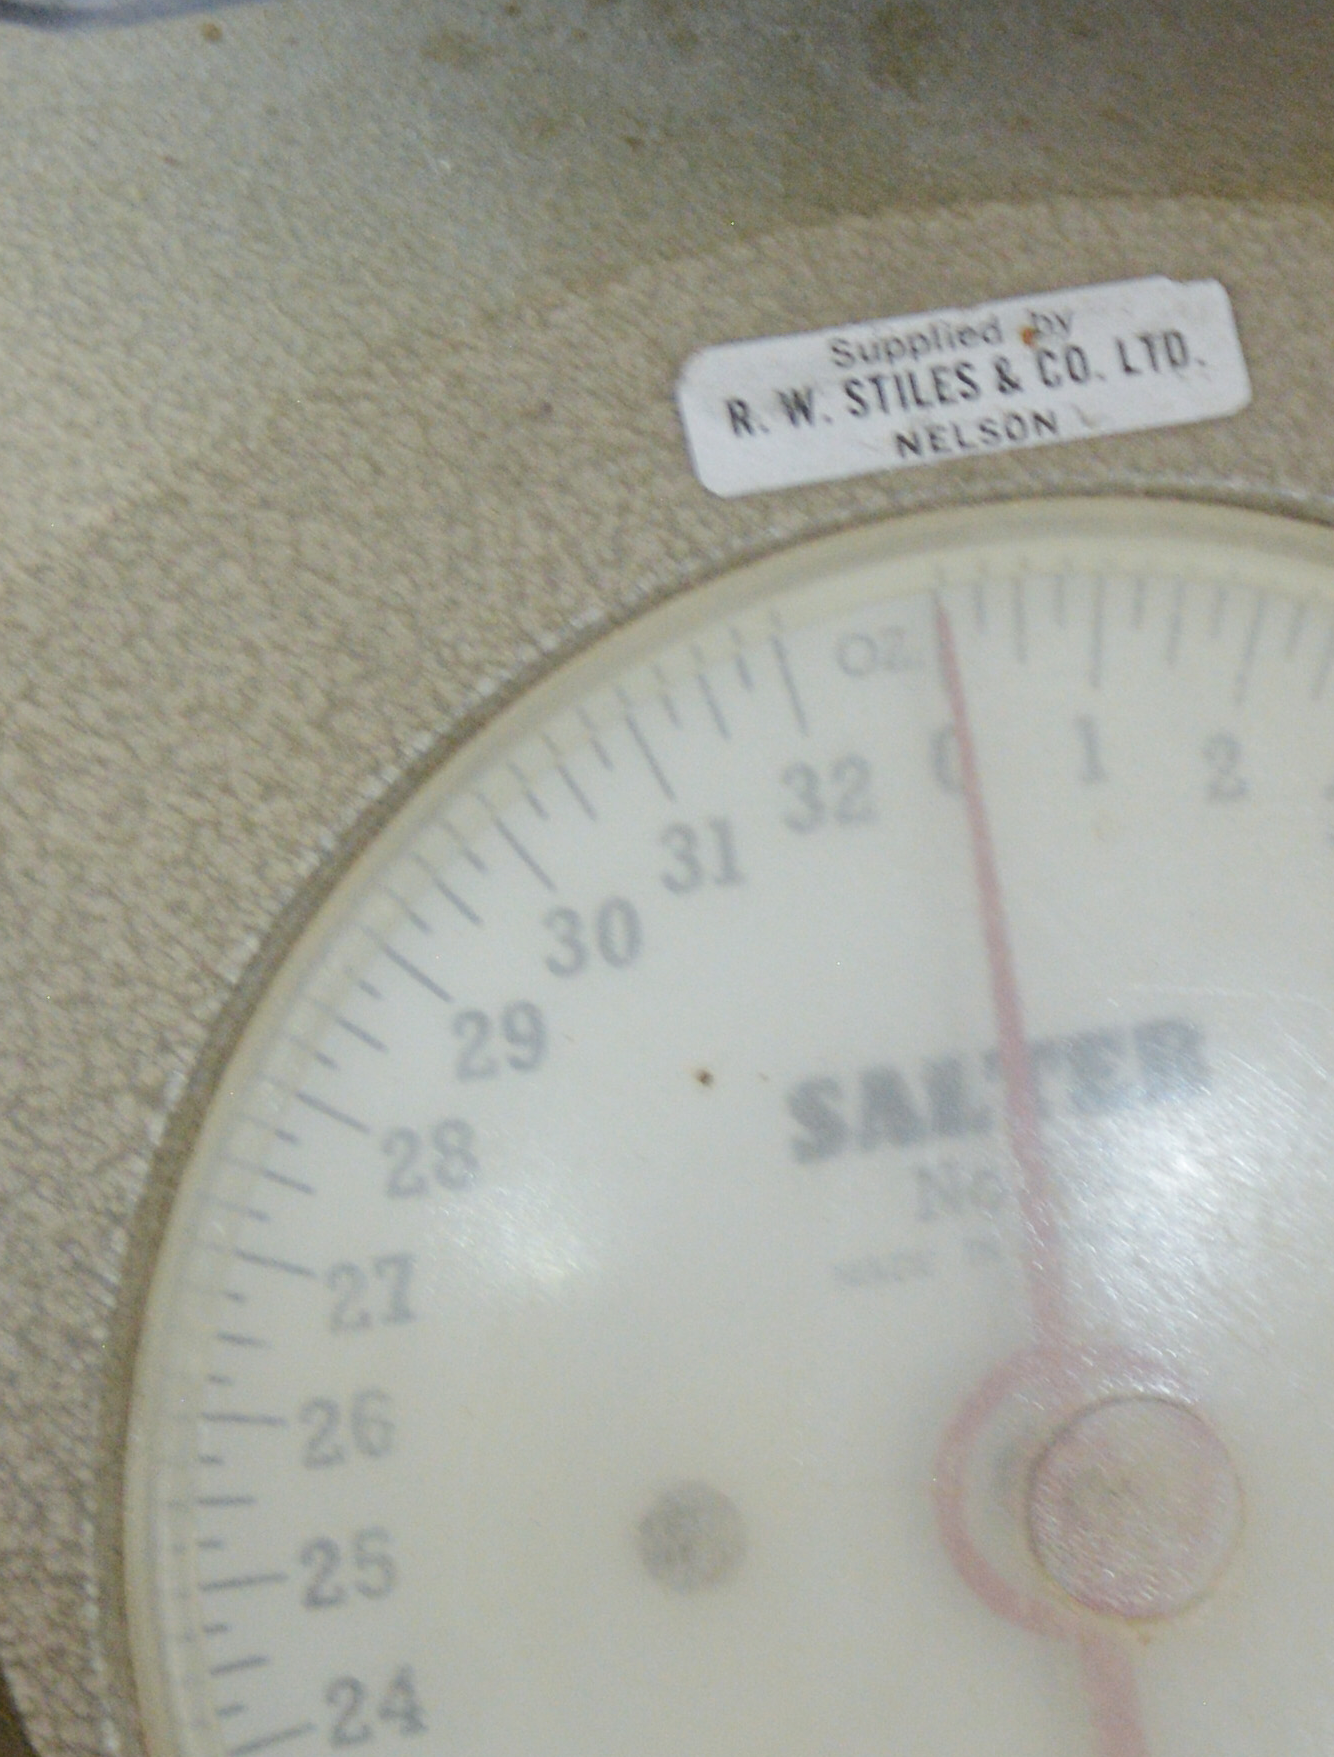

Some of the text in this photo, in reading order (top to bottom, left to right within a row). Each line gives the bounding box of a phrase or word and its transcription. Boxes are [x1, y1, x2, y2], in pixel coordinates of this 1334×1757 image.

[829, 309, 1076, 369] Supplied by
[722, 327, 1209, 439] R. W. STILES & CO. LTD.
[893, 407, 1060, 460] NELSON
[1075, 714, 1107, 786] 1
[1202, 734, 1248, 804] 2
[779, 754, 877, 836] 32
[659, 815, 745, 895] 31
[541, 896, 644, 978] 30
[452, 999, 549, 1083] 29
[786, 1018, 1210, 1166] SALTER
[380, 1118, 479, 1200] 28
[325, 1253, 418, 1334] 27
[299, 1388, 397, 1470] 26
[298, 1526, 399, 1610] 25
[323, 1665, 428, 1750] 24
